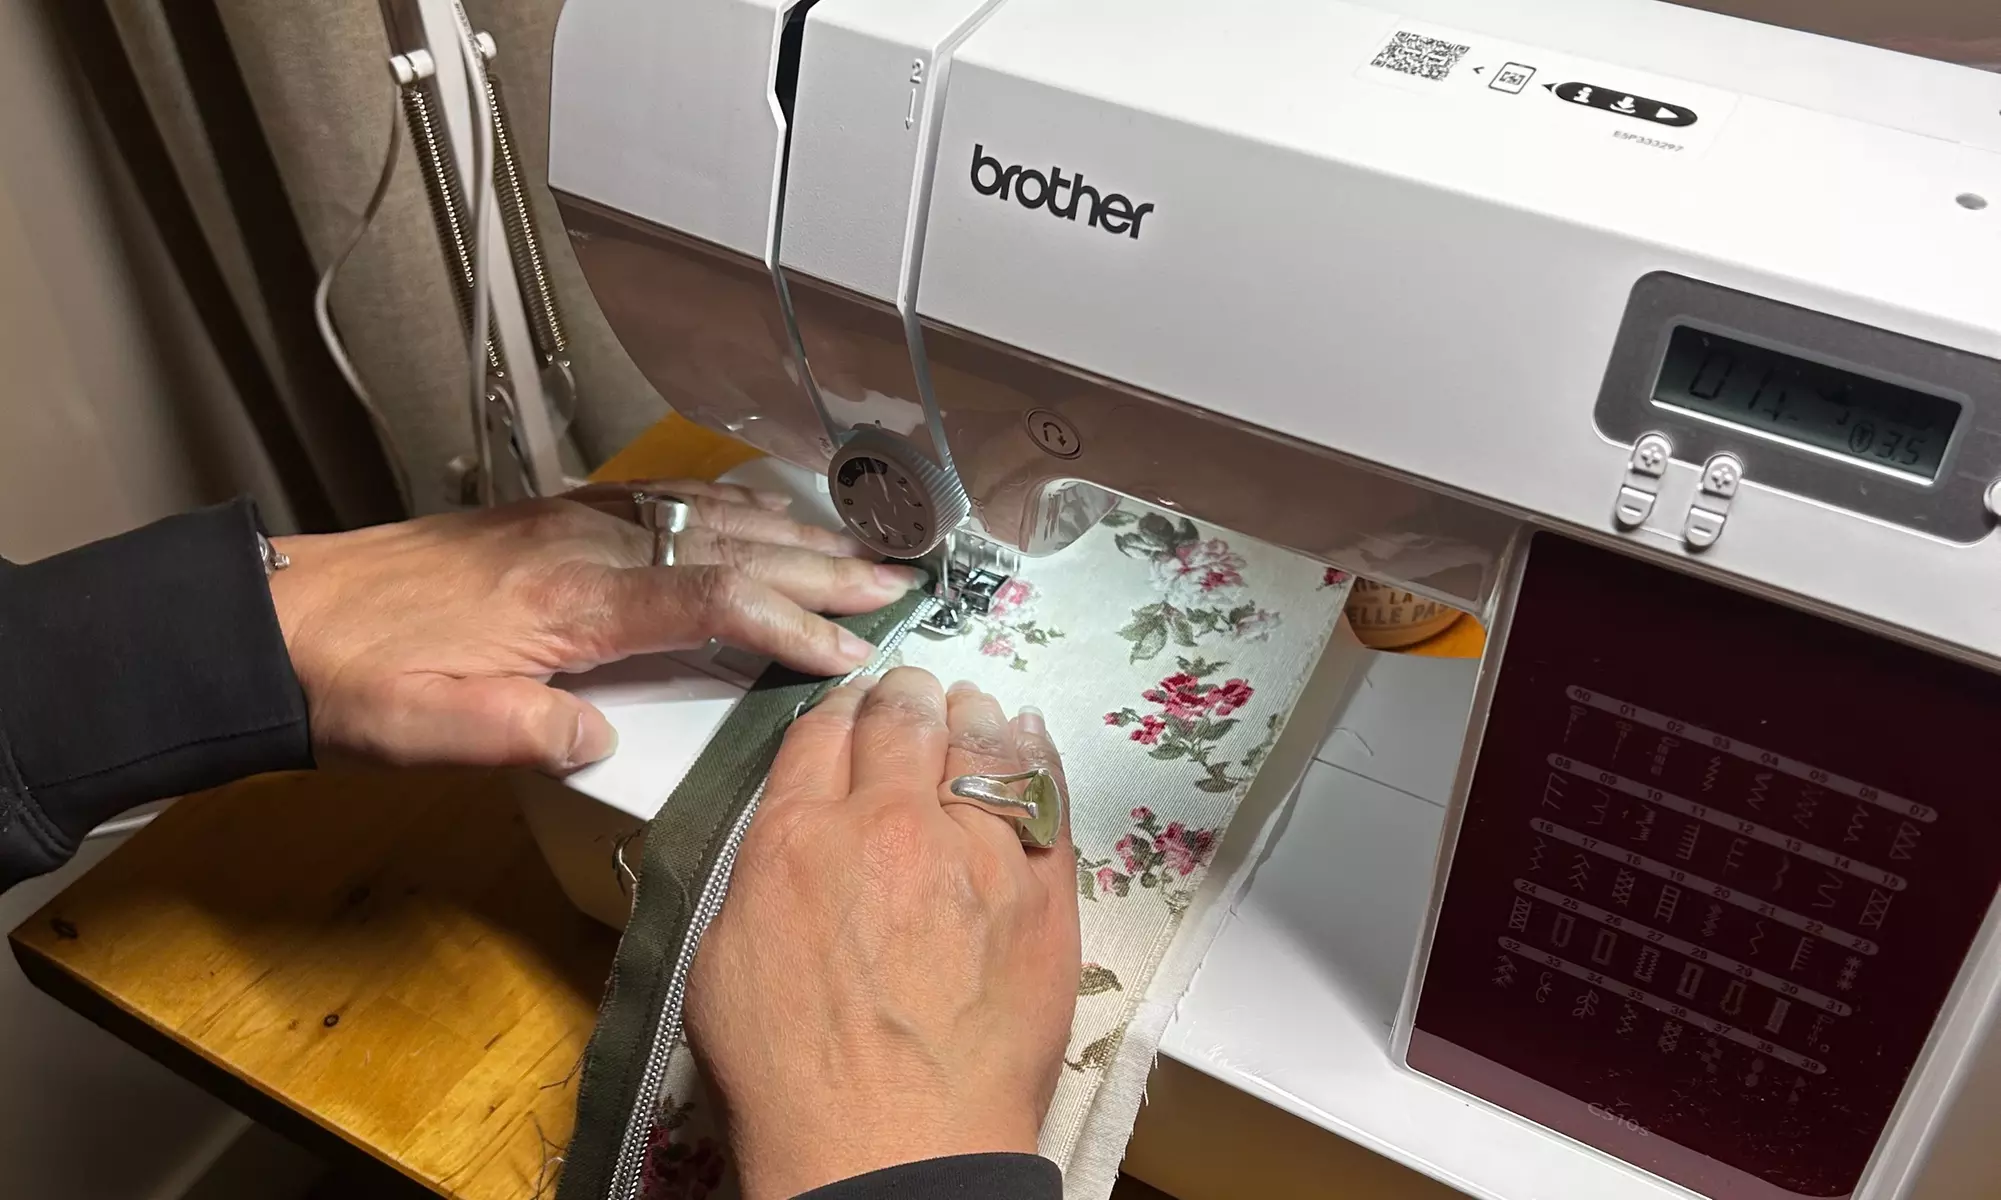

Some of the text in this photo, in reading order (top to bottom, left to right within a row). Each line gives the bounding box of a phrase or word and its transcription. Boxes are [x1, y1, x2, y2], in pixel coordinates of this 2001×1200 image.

[909, 58, 925, 85] 2
[970, 143, 1155, 239] brother
[1389, 591, 1413, 605] LA
[1620, 704, 1636, 717] 01
[1667, 720, 1685, 734] 02
[1760, 753, 1779, 767] 04
[1909, 804, 1929, 818] 07
[1599, 772, 1617, 785] 09
[1647, 789, 1664, 802] 10
[1737, 820, 1755, 835] 12
[1834, 857, 1851, 870] 14
[1520, 881, 1537, 895] 24
[1562, 897, 1580, 911] 25
[1604, 913, 1623, 927] 26
[1646, 930, 1665, 943] 27
[1735, 964, 1753, 978] 29
[1780, 982, 1799, 995] 30
[1539, 821, 1554, 834] 16
[1581, 836, 1598, 849] 17
[1669, 869, 1686, 882] 19
[1713, 886, 1731, 899] 20
[1757, 903, 1776, 917] 21
[1806, 920, 1825, 934] 22
[1851, 939, 1871, 953] 23
[1504, 939, 1818, 1071] 32 33 34 35 36 37 38 39
